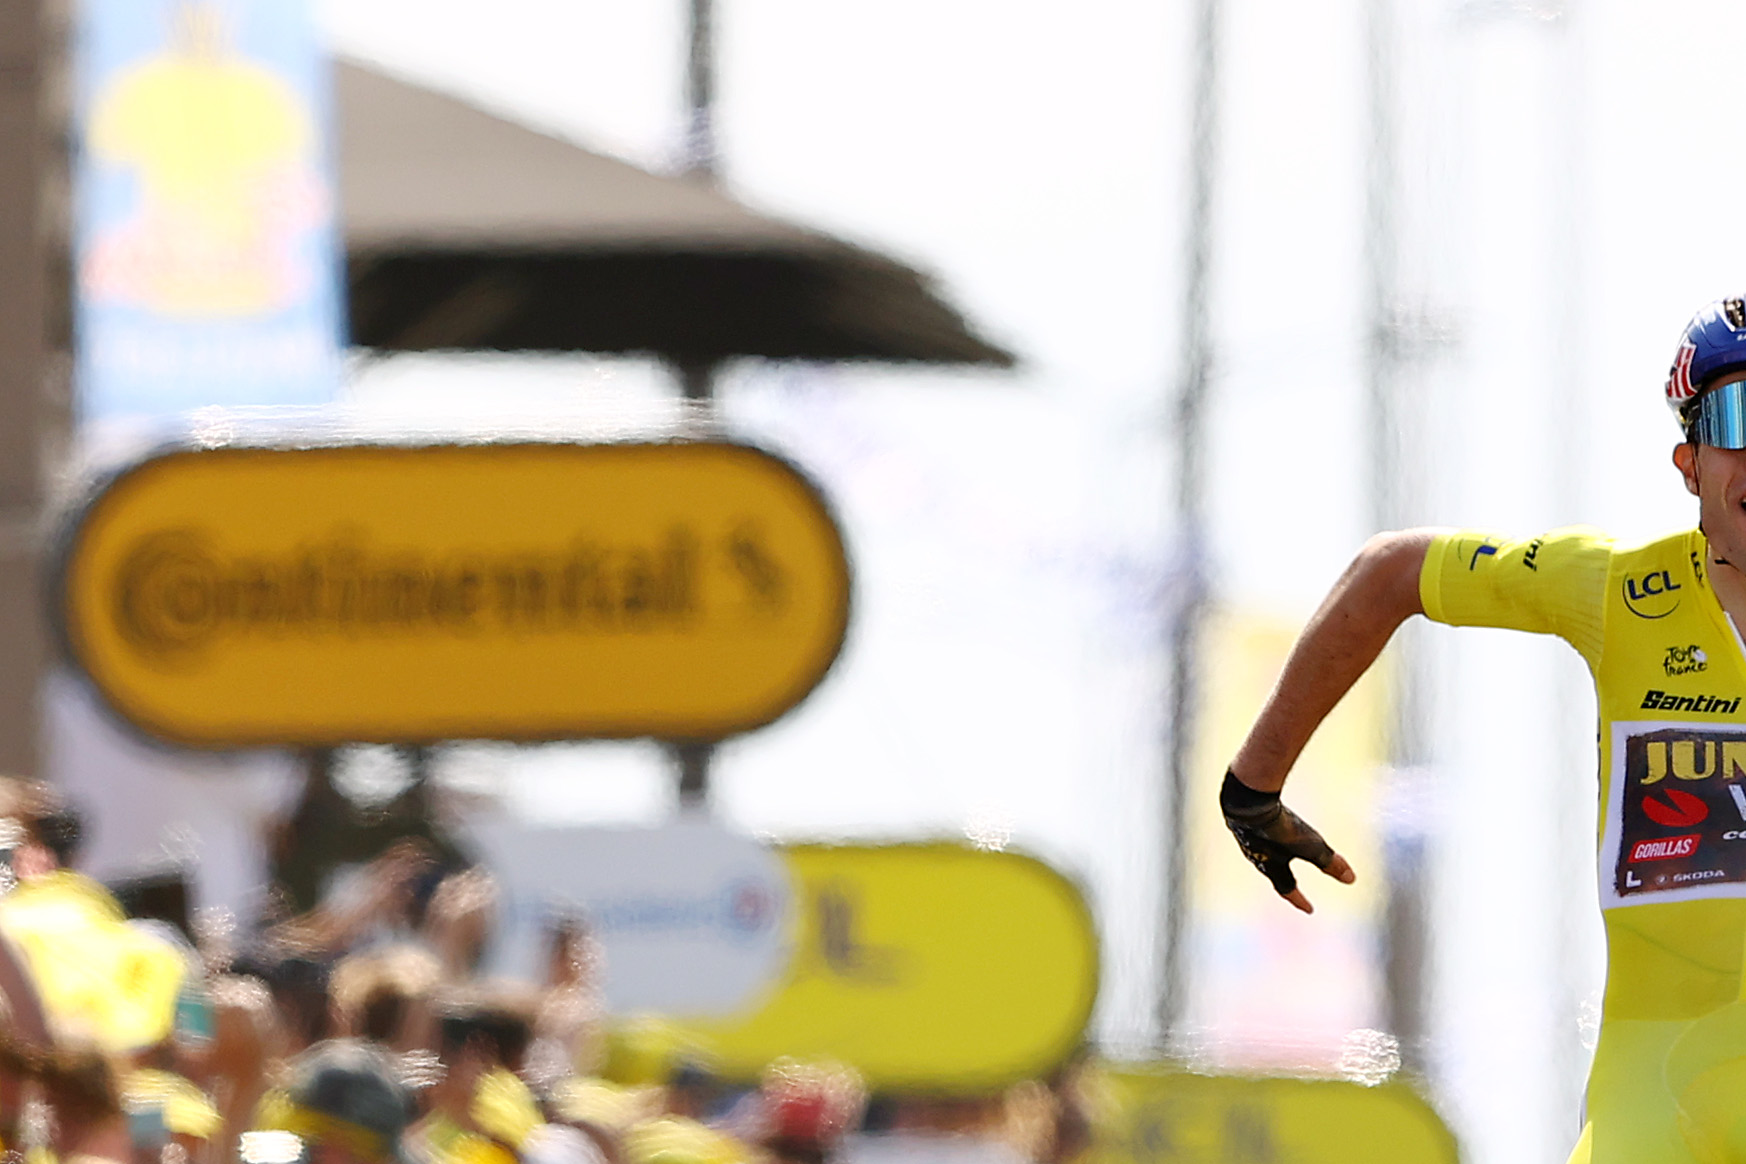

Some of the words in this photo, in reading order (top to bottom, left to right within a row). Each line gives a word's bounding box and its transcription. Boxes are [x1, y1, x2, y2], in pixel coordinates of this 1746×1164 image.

[1626, 569, 1681, 601] LCL
[1639, 689, 1742, 714] Santini
[1634, 838, 1693, 860] GORILLAS
